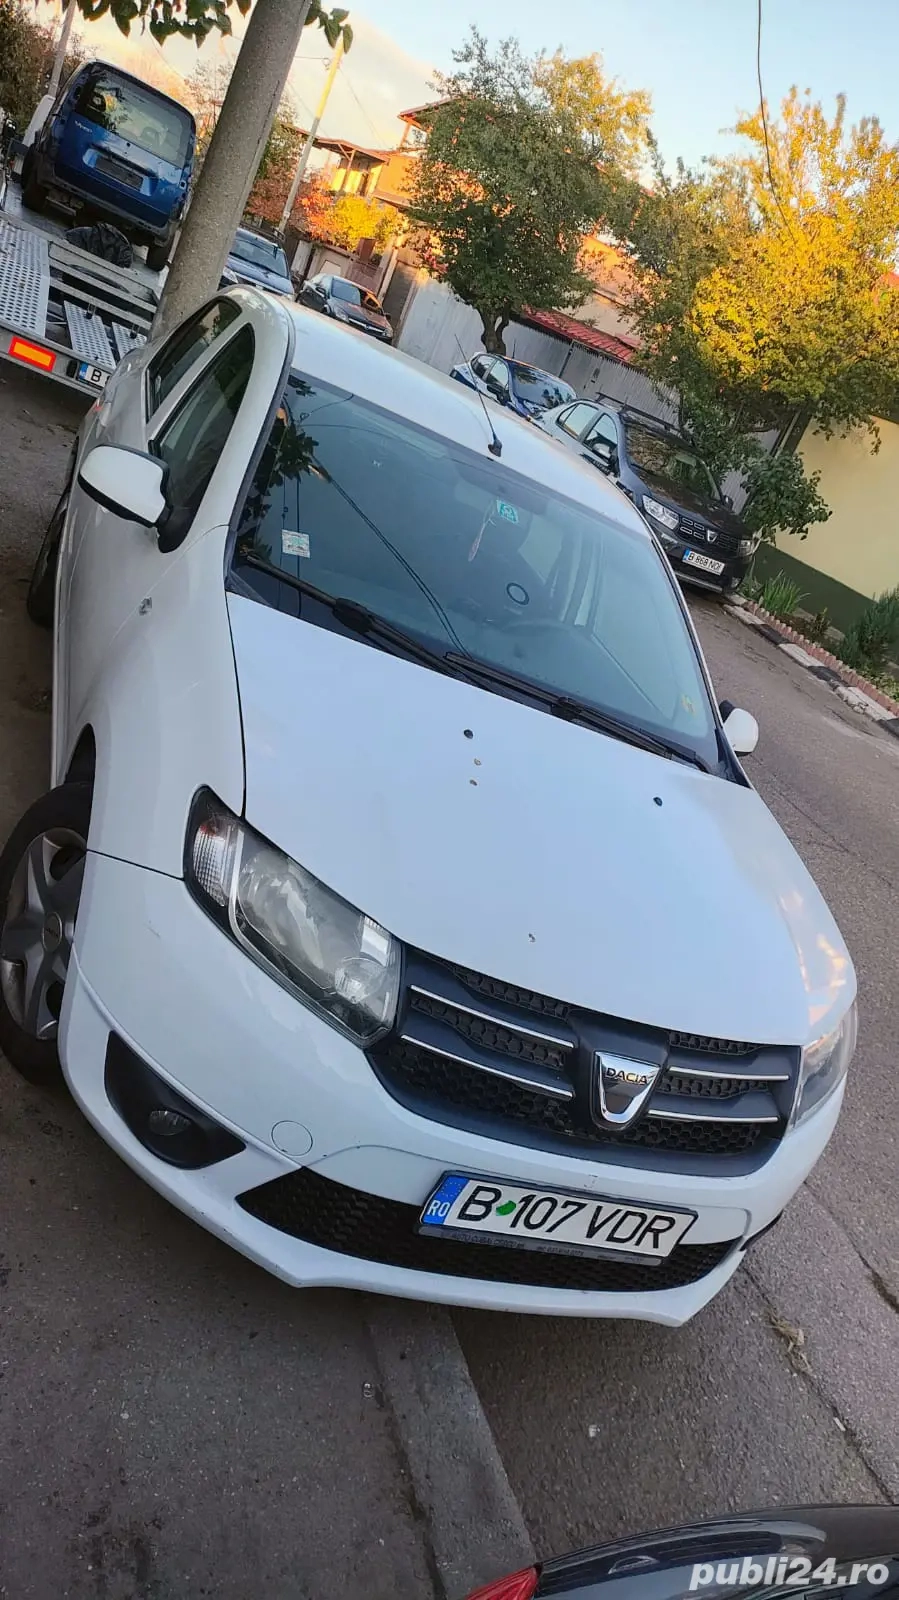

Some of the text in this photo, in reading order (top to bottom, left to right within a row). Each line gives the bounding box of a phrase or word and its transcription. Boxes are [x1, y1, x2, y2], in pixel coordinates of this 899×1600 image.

[687, 552, 695, 561] B
[606, 1067, 648, 1085] DACIA
[427, 1199, 450, 1218] RO
[457, 1185, 502, 1222] B
[509, 1194, 588, 1233] 107
[585, 1205, 676, 1249] VDR
